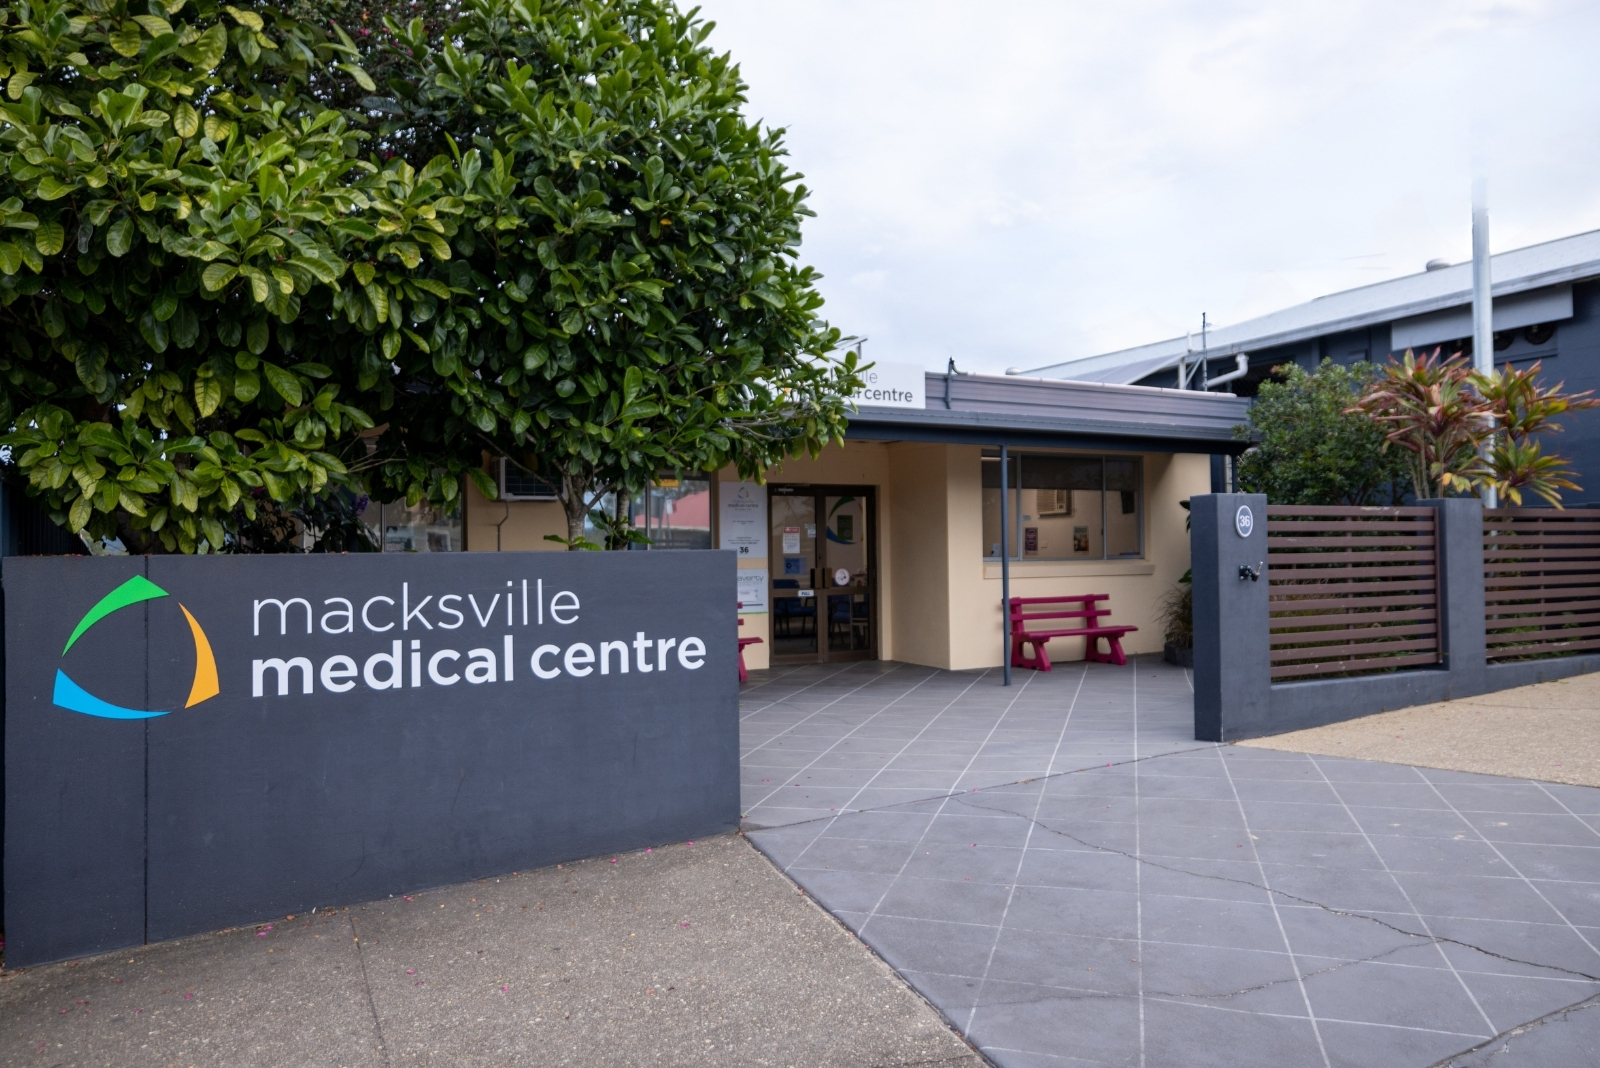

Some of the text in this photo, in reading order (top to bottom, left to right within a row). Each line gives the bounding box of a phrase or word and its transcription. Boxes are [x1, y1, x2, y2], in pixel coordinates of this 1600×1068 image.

[864, 387, 914, 403] centre
[1239, 515, 1251, 527] 36
[739, 546, 749, 554] 36
[252, 578, 581, 637] macksville
[252, 631, 707, 698] medical centre
